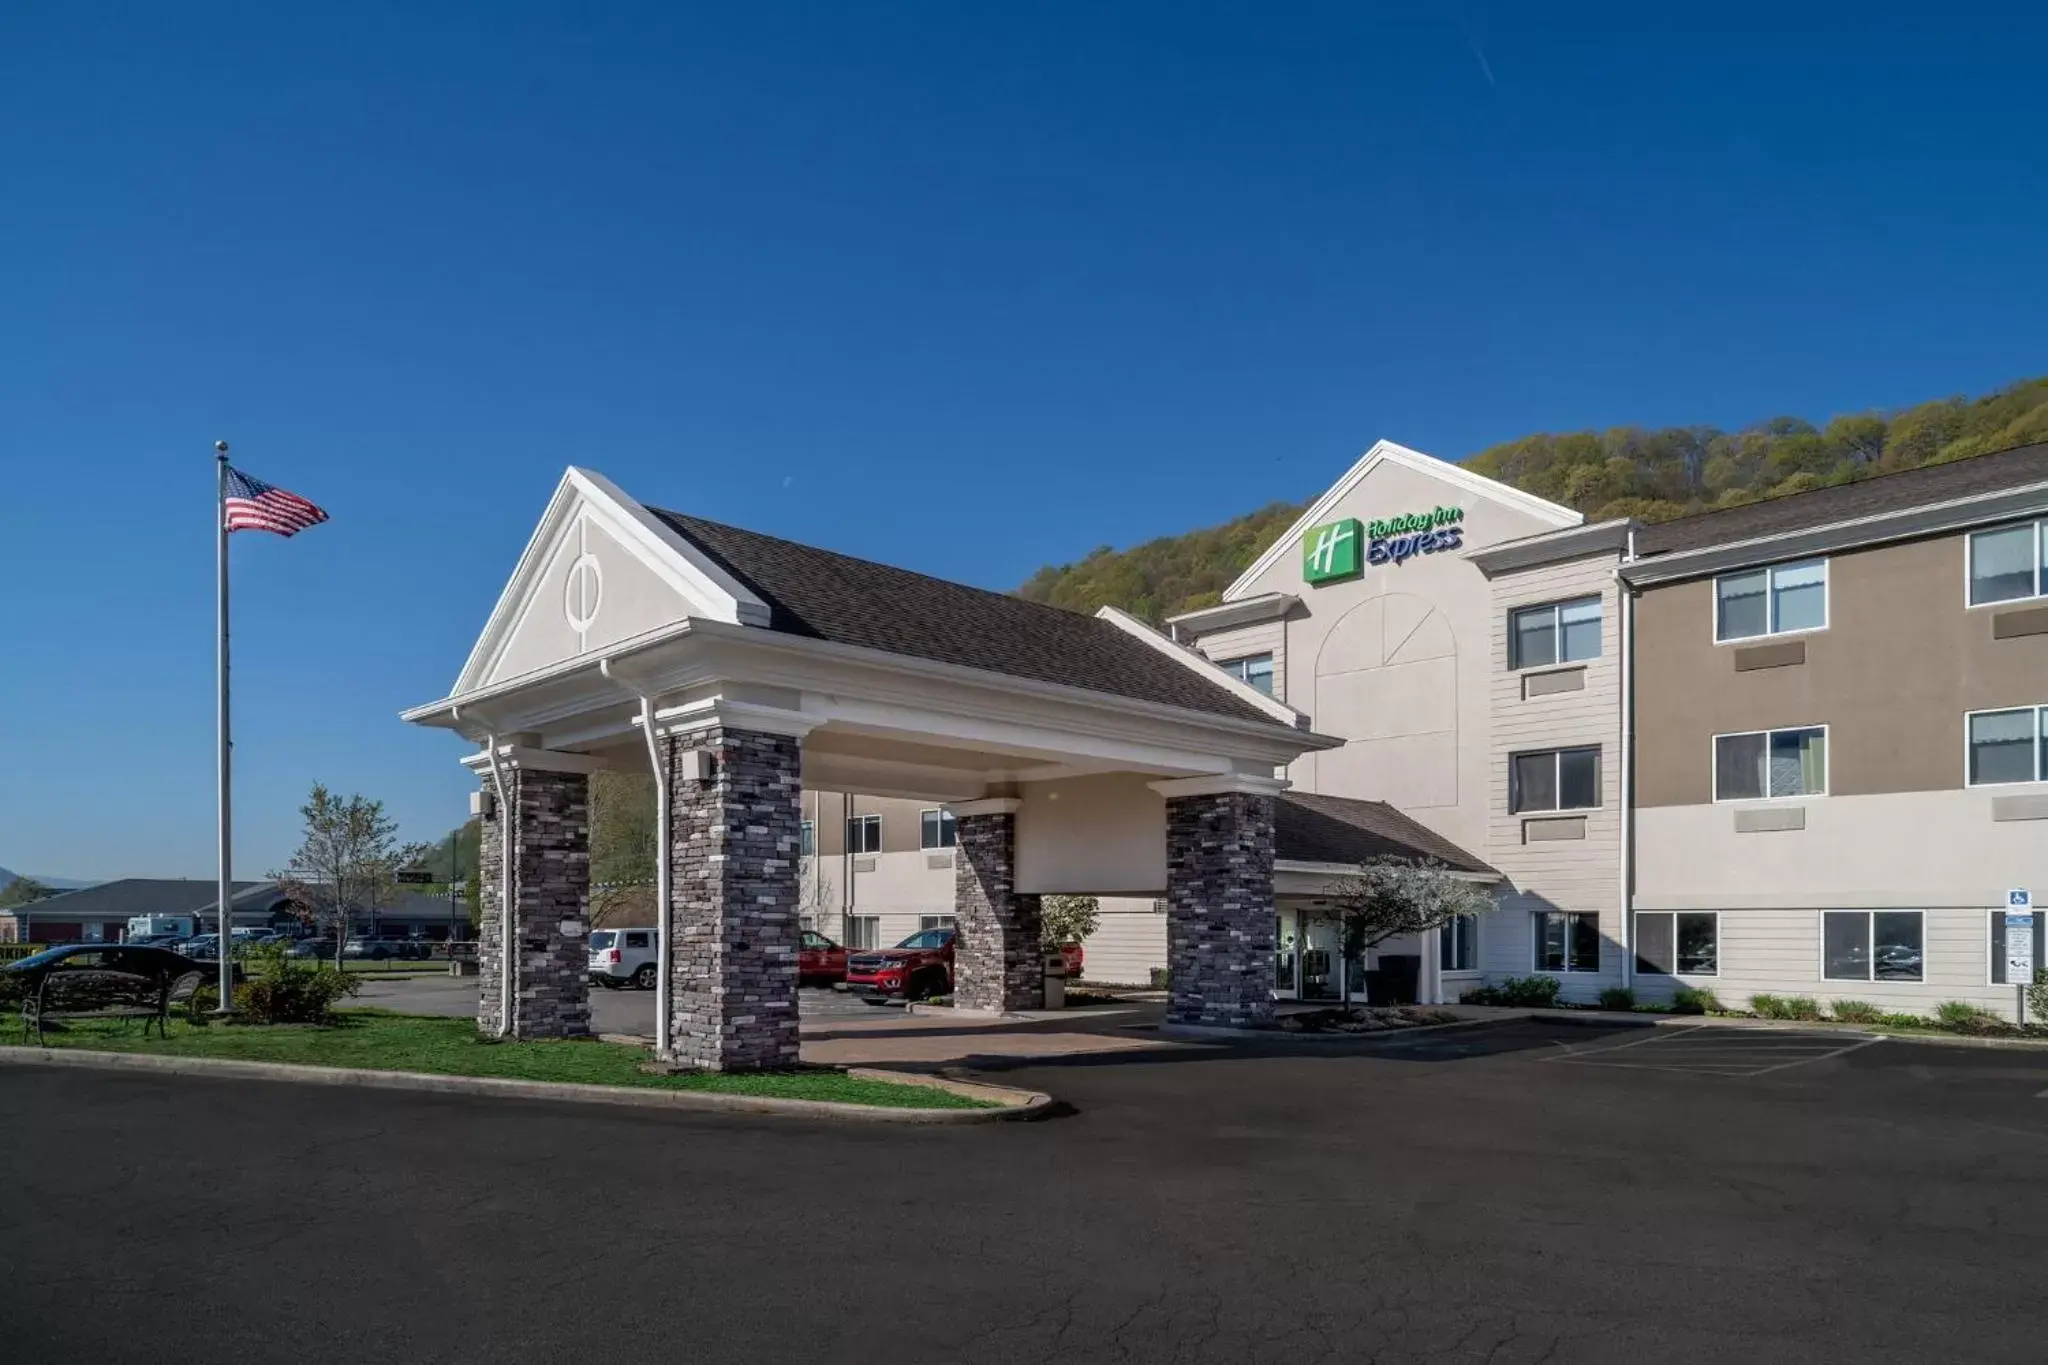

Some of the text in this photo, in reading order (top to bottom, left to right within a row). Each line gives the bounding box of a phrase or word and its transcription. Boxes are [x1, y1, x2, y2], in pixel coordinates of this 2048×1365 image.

[1368, 505, 1464, 539] Holiday Inn
[1308, 523, 1354, 573] H
[1366, 526, 1464, 567] Express
